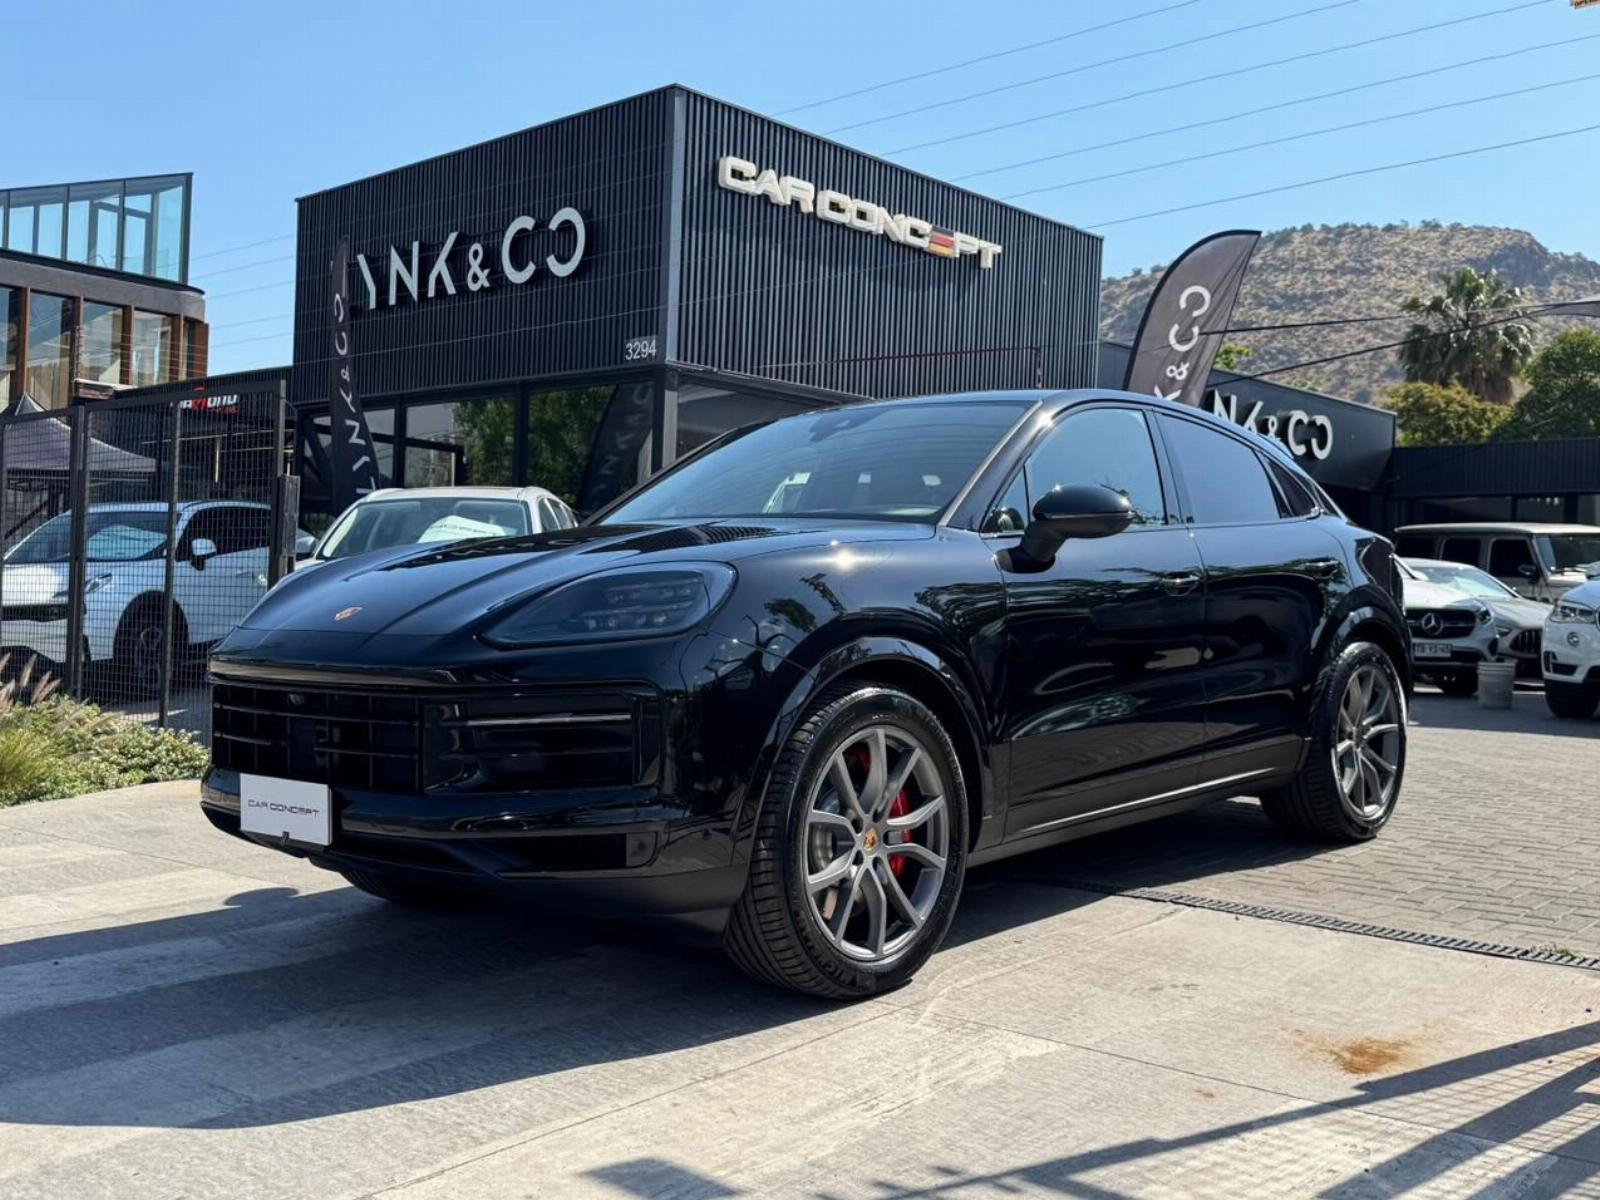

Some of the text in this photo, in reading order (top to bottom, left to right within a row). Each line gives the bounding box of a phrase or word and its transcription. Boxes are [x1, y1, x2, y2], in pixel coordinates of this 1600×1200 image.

[718, 156, 815, 214] CAR
[625, 339, 657, 361] 3294
[248, 799, 268, 809] CAR
